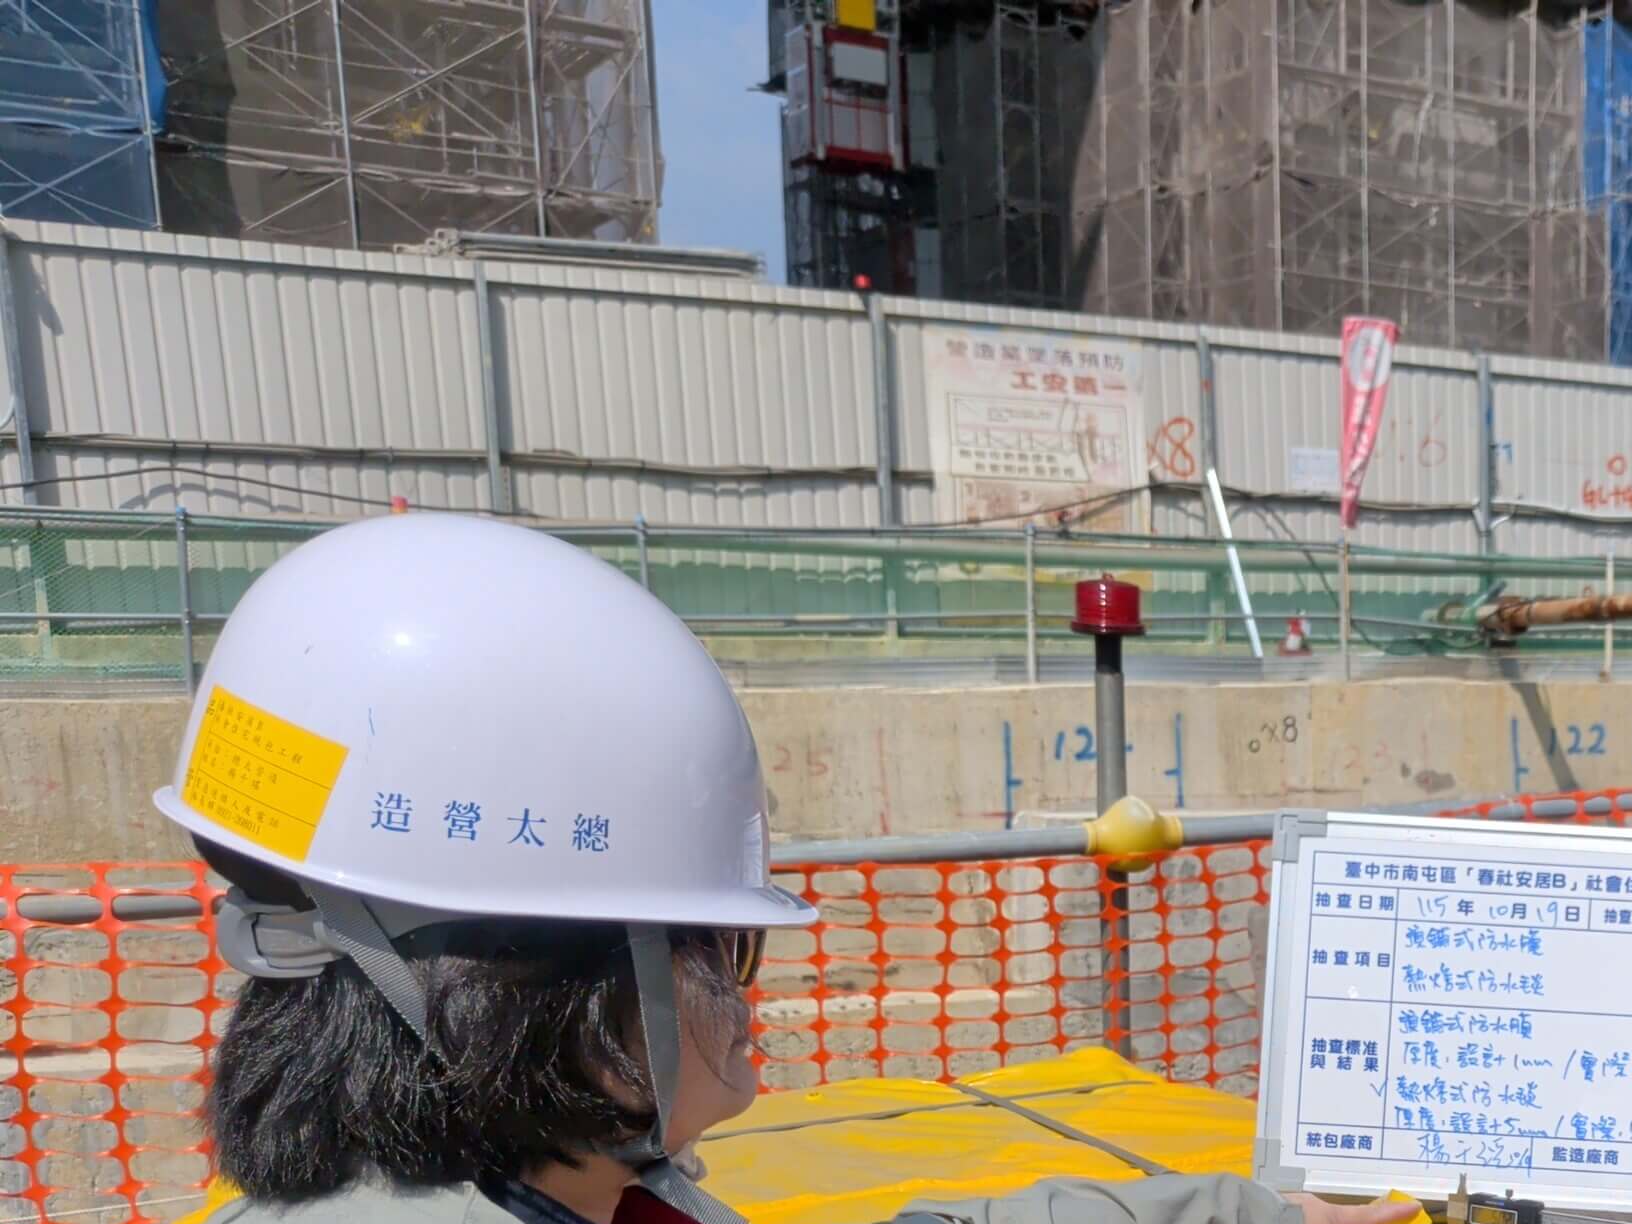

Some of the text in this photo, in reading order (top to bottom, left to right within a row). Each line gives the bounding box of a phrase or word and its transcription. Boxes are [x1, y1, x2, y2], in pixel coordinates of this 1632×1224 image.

[1546, 724, 1607, 755] 122
[1315, 891, 1395, 912] 抽查日期
[1312, 949, 1392, 968] 抽查項目
[1310, 1054, 1379, 1073] 與結果
[1306, 1132, 1373, 1151] 統包廠商
[1551, 1147, 1619, 1166] 監造廠商
